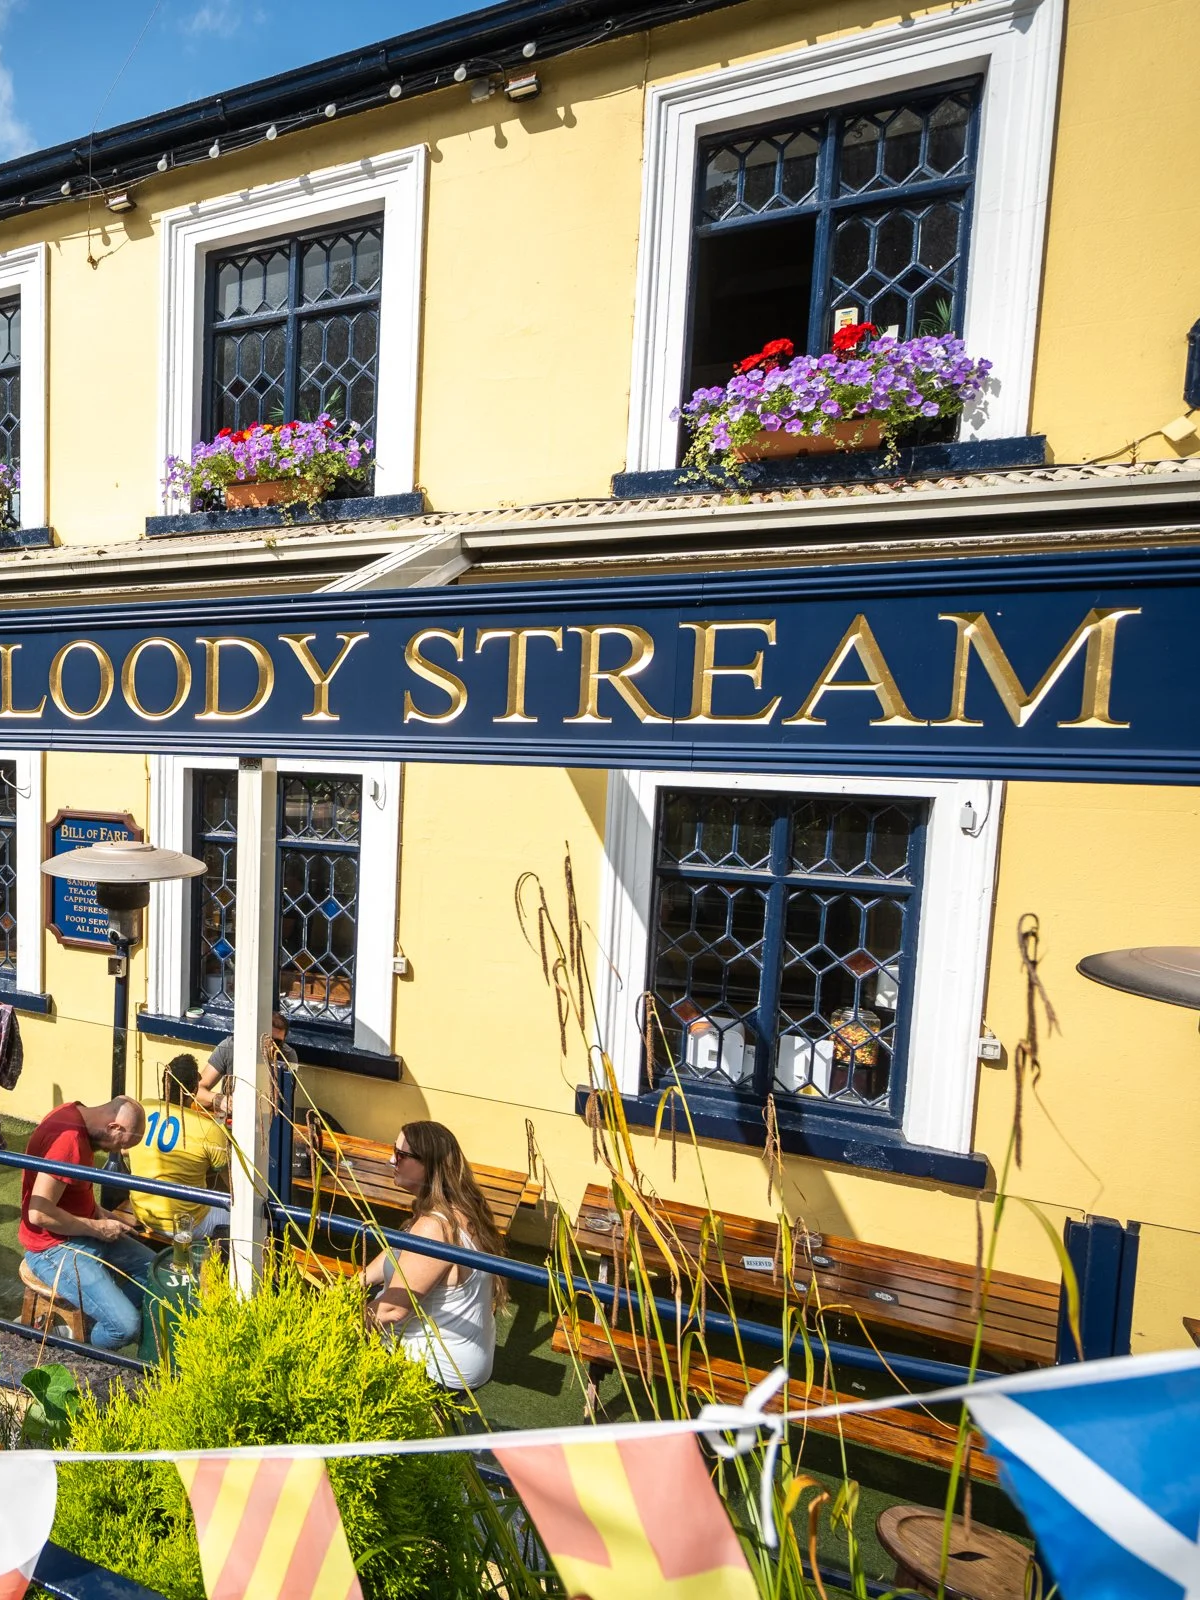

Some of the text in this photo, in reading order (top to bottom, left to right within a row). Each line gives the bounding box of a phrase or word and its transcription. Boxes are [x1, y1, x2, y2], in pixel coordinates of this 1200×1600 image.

[403, 606, 1143, 730] STREAM
[60, 824, 129, 841] BILL OF FARE
[66, 880, 96, 888] SANDW
[63, 895, 99, 906] CAPPUCC
[73, 905, 109, 915] ESPRESS
[65, 915, 109, 927] FOOD SERV
[76, 925, 109, 935] ALL DAY
[145, 1111, 180, 1153] 10
